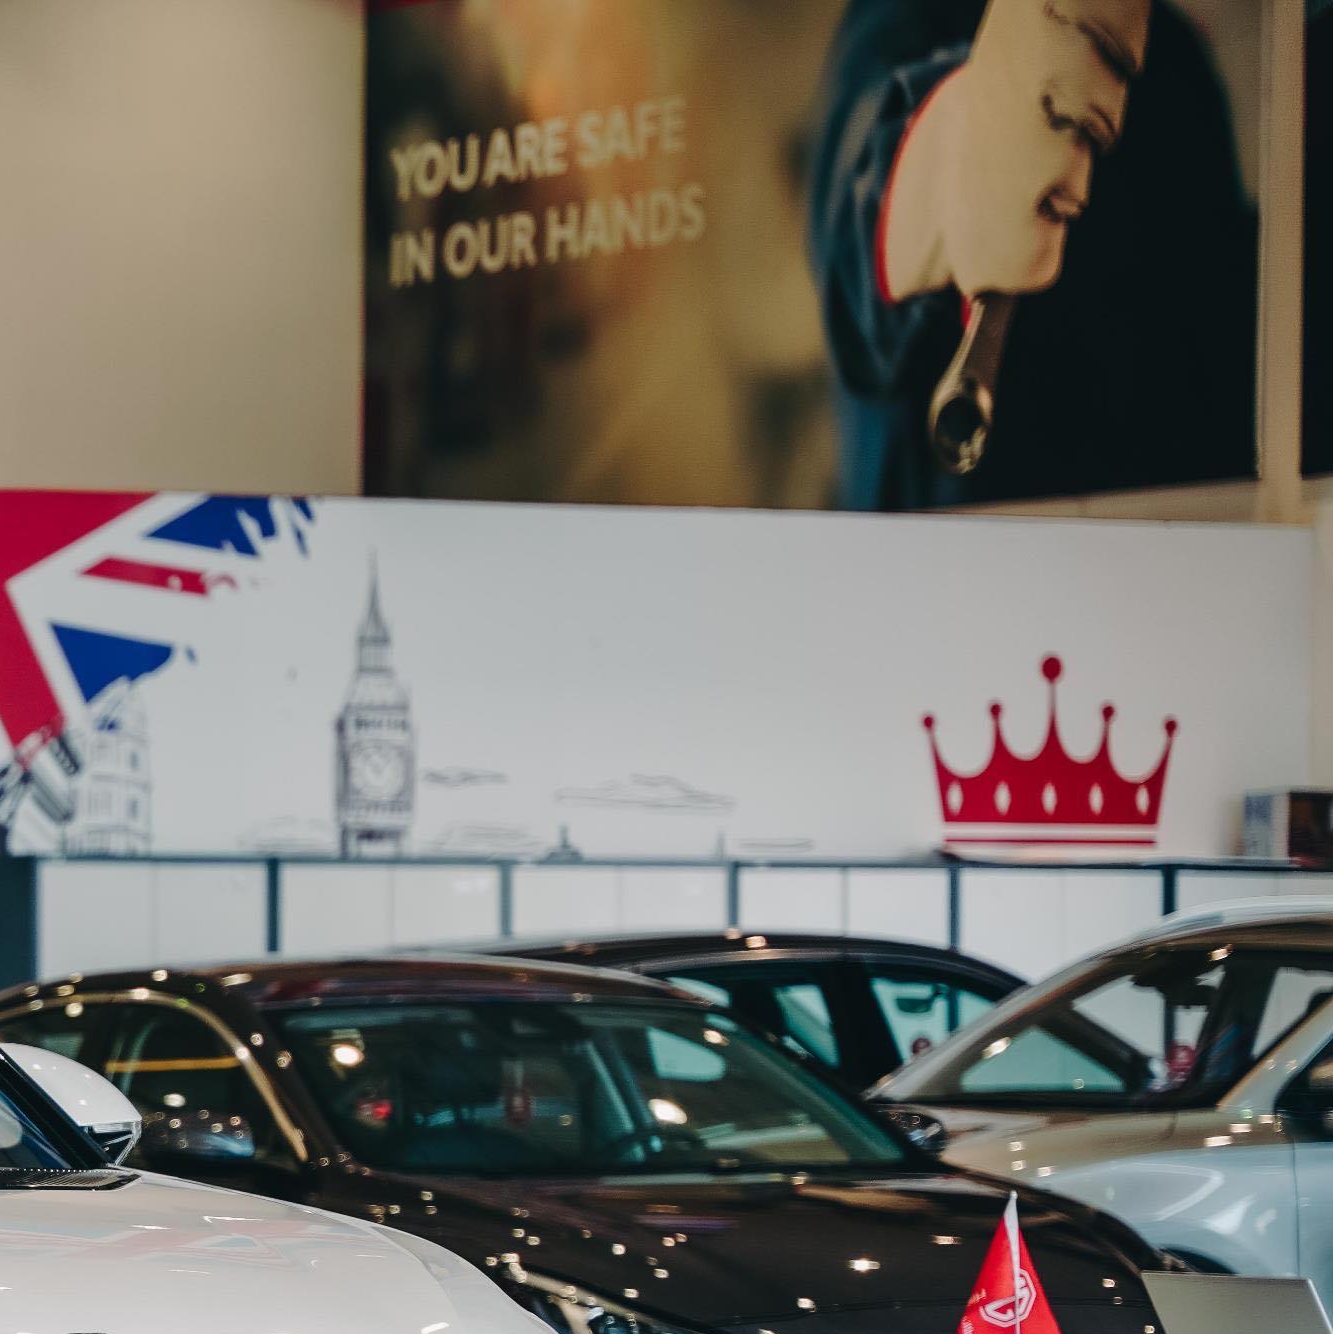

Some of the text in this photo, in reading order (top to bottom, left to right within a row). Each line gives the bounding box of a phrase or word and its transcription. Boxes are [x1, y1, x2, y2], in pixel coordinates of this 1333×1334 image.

[389, 98, 687, 201] YOU ARE SAFE
[389, 182, 706, 288] IN OUR HANDS
